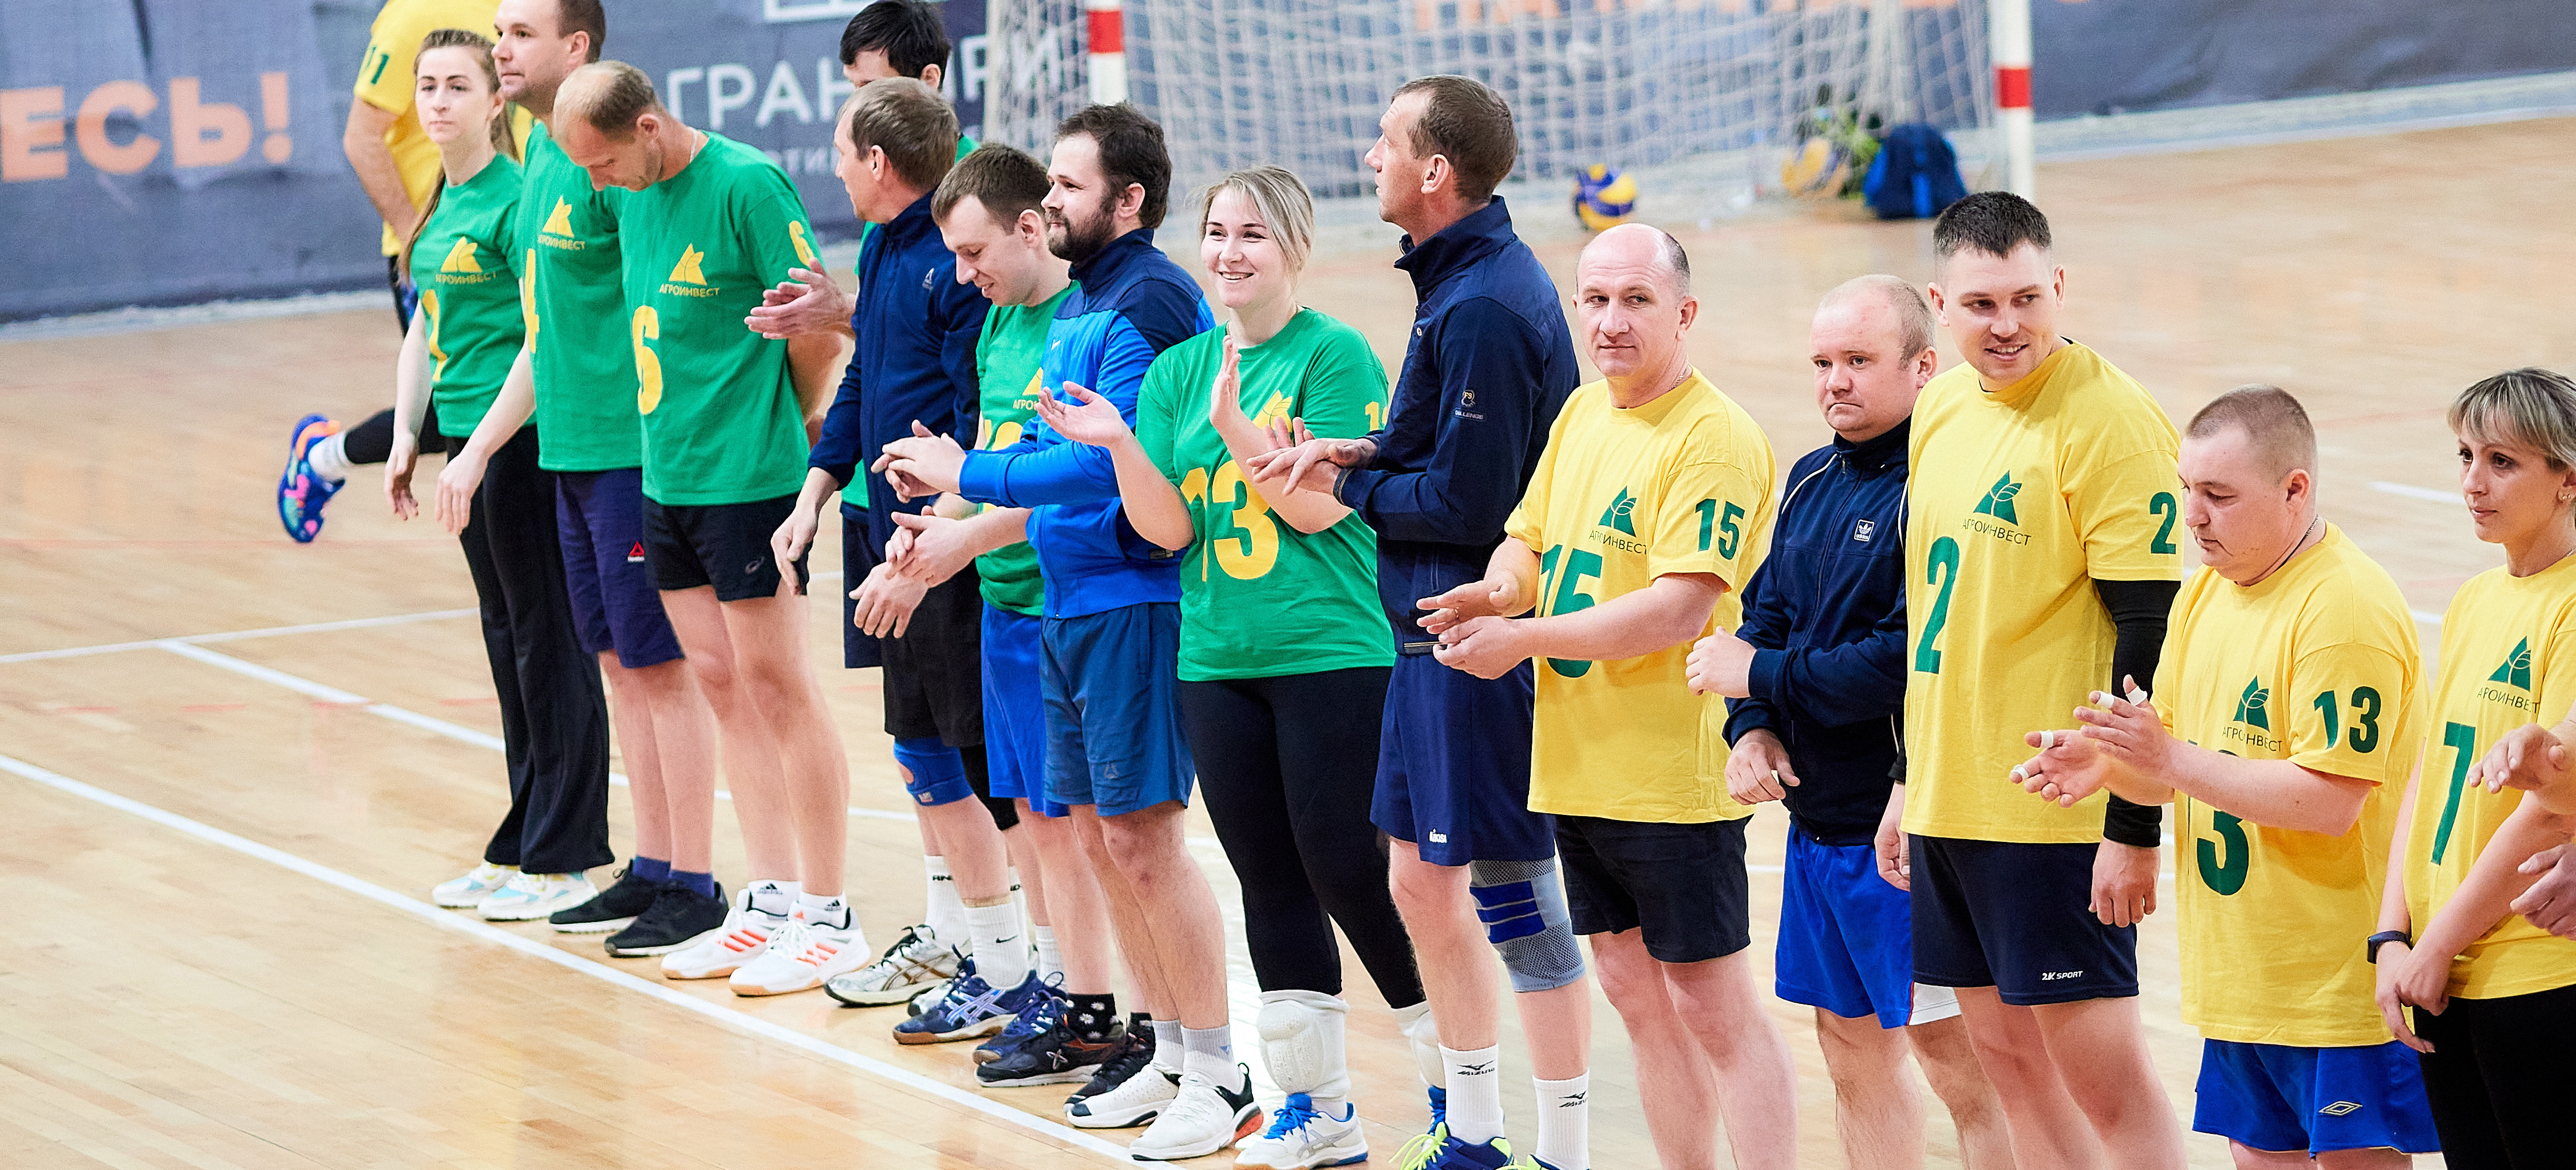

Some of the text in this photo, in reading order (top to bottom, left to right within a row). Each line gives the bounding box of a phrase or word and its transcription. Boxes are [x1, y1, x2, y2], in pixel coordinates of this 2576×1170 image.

[789, 220, 814, 267] 6
[659, 283, 720, 298] АГРОИНВЕСТ
[632, 305, 663, 415] 6
[1695, 498, 1745, 560] 15
[1962, 515, 2032, 546] АГРОИНВЕСТ
[2150, 491, 2177, 555] 2
[1914, 535, 1960, 675] 2
[2313, 685, 2381, 754] 13
[2431, 721, 2476, 866] 7
[2056, 970, 2083, 979] SPORT
[1457, 1067, 1495, 1076] MIZUNO
